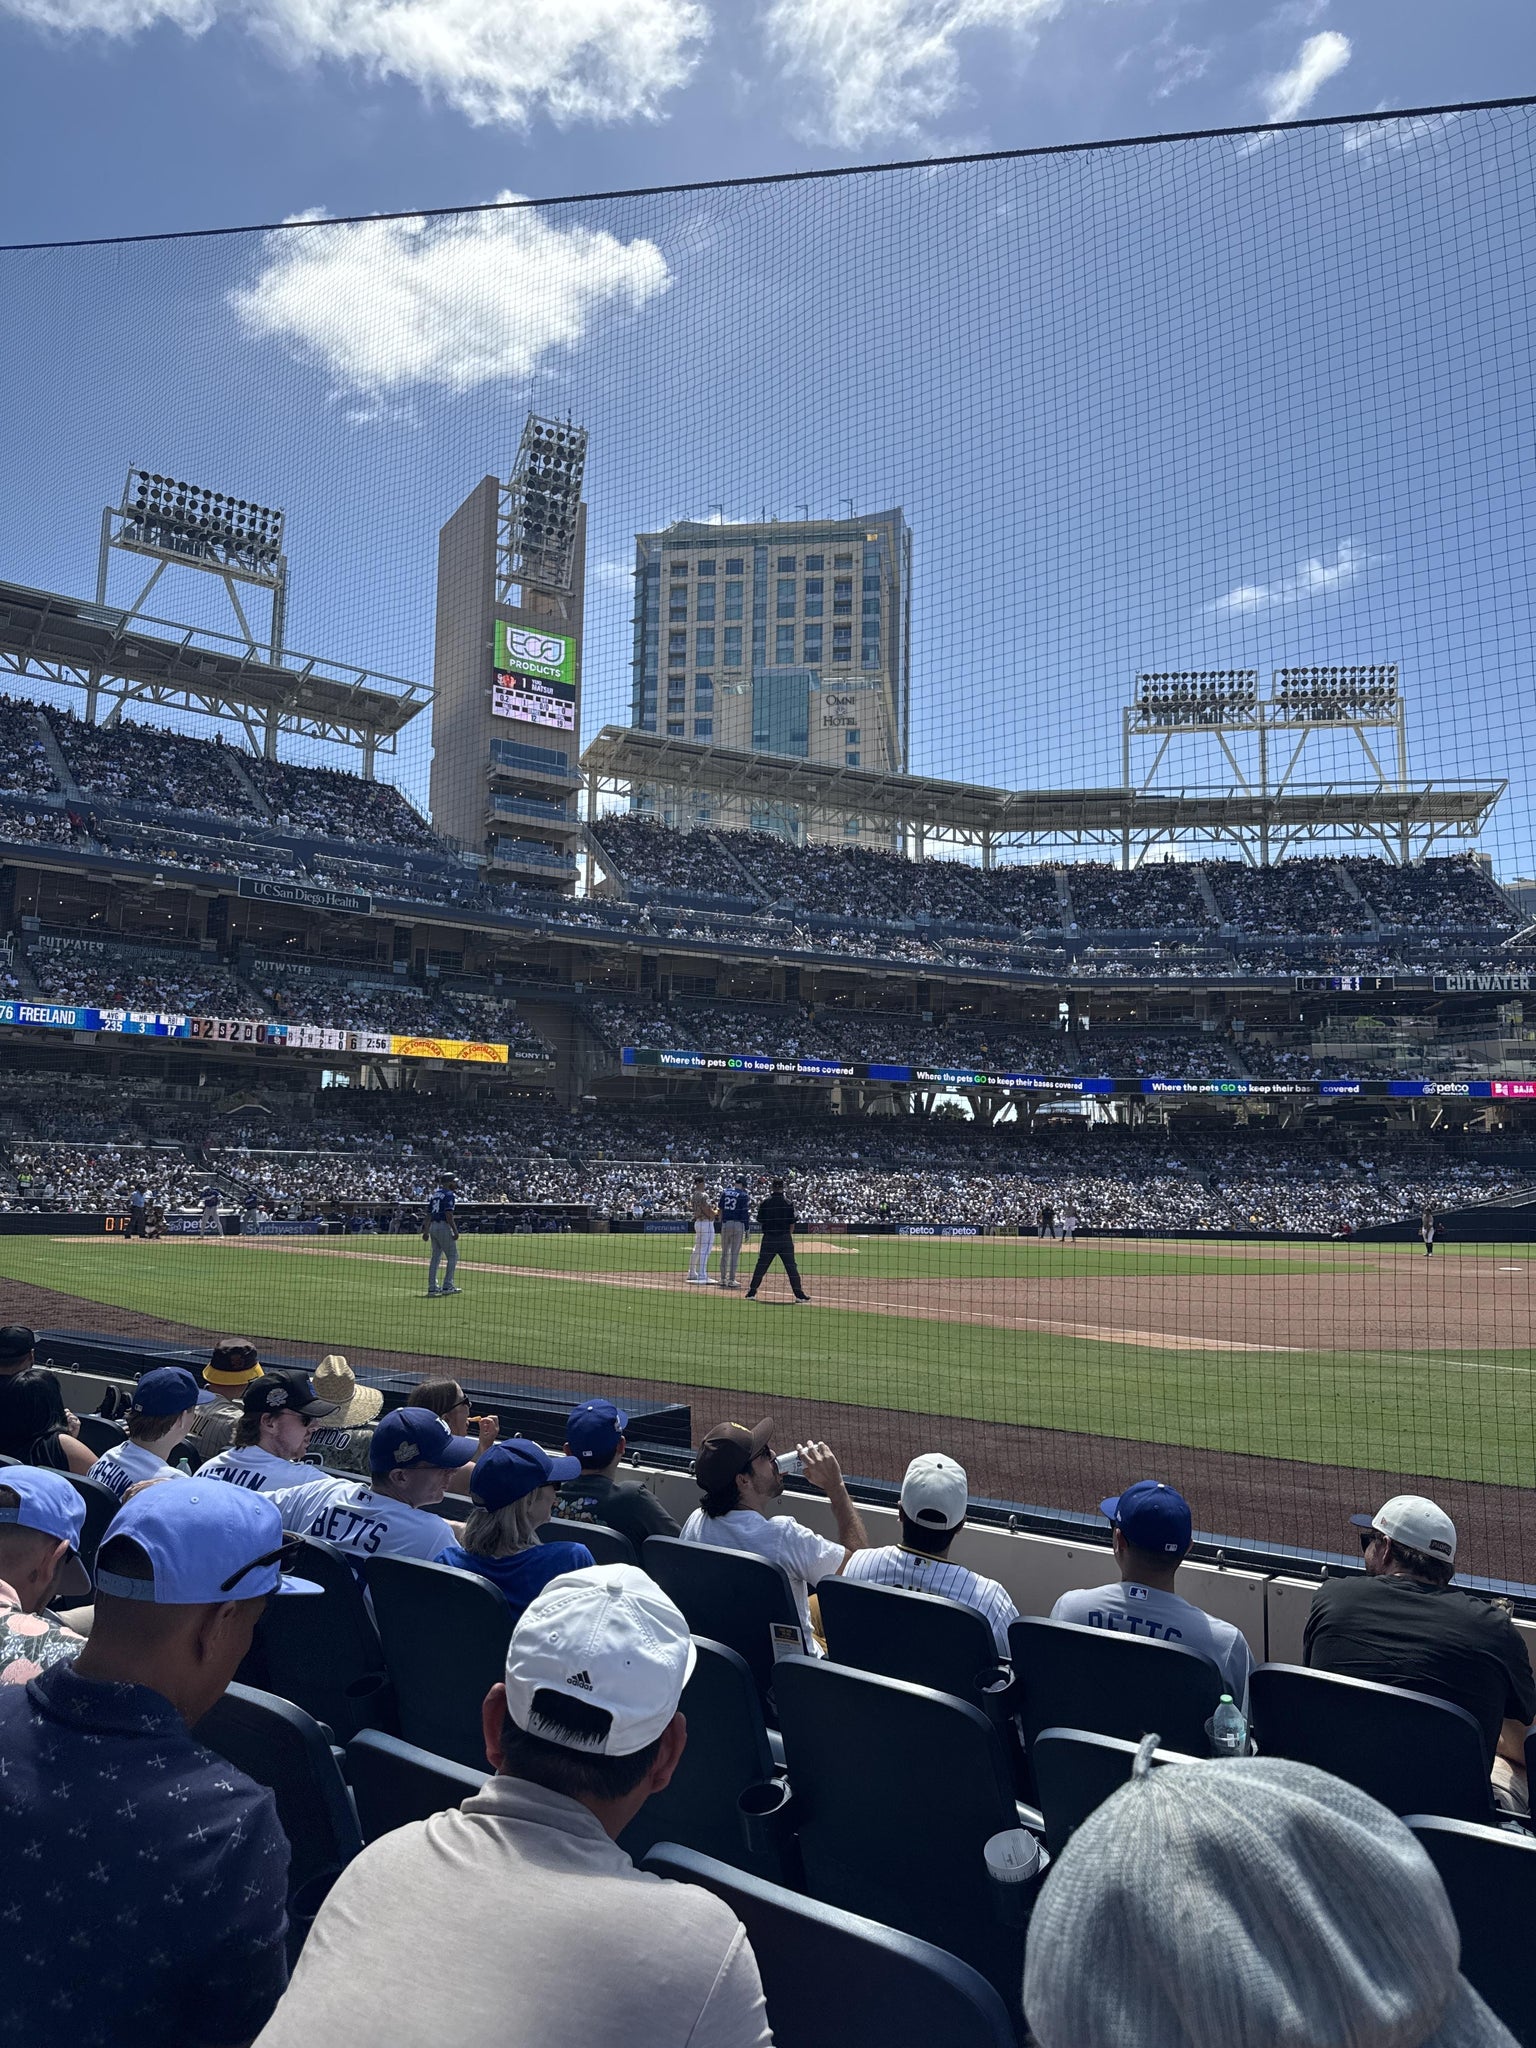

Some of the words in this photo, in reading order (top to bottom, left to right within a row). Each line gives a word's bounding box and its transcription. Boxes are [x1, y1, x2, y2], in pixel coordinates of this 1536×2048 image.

[508, 628, 564, 664] ECO
[510, 658, 562, 678] PRODUCTS
[522, 678, 526, 688] 1
[532, 684, 554, 695] MATSUI
[826, 694, 855, 705] OMNI
[824, 716, 857, 726] HOTEL
[254, 882, 272, 896] UC
[272, 885, 294, 899] San
[295, 889, 325, 905] Diego
[326, 892, 359, 909] Health
[254, 960, 311, 976] CUTWATER
[1376, 979, 1381, 989] F
[1446, 978, 1530, 990] CUTWATER
[0, 1005, 13, 1020] 76
[19, 1006, 76, 1025] FREELAND
[101, 1020, 122, 1032] .235
[139, 1024, 145, 1034] 3
[167, 1025, 176, 1036] 17
[193, 1023, 198, 1032] B
[203, 1022, 213, 1038] 2
[220, 1025, 225, 1035] S
[230, 1023, 240, 1040] 2
[329, 1036, 332, 1044] E
[339, 1031, 344, 1040] 0
[319, 1039, 324, 1048] 2
[339, 1041, 343, 1050] 0
[351, 1039, 357, 1049] 6
[367, 1038, 386, 1049] 2:56
[411, 1042, 441, 1056] FORTALEZA
[660, 1054, 690, 1065] Where
[691, 1057, 705, 1066] the
[707, 1058, 726, 1068] pets
[728, 1059, 742, 1068] GO
[744, 1060, 753, 1069] to
[754, 1060, 775, 1072] keep
[776, 1062, 795, 1072] their
[797, 1063, 820, 1073] bases
[821, 1065, 854, 1075] covered
[916, 1071, 941, 1080] Where
[943, 1073, 955, 1081] the
[956, 1074, 973, 1083] pets
[974, 1075, 986, 1083] GO
[997, 1077, 1014, 1087] keep
[1016, 1078, 1032, 1087] their
[1034, 1079, 1054, 1088] bases
[1055, 1081, 1083, 1090] covered
[1199, 1084, 1219, 1093] pets
[1249, 1084, 1270, 1094] keep
[1272, 1084, 1293, 1092] their
[1437, 1083, 1469, 1094] petco
[724, 1197, 737, 1210] 23
[310, 1506, 388, 1554] BETTS
[566, 1678, 593, 1691] adidas
